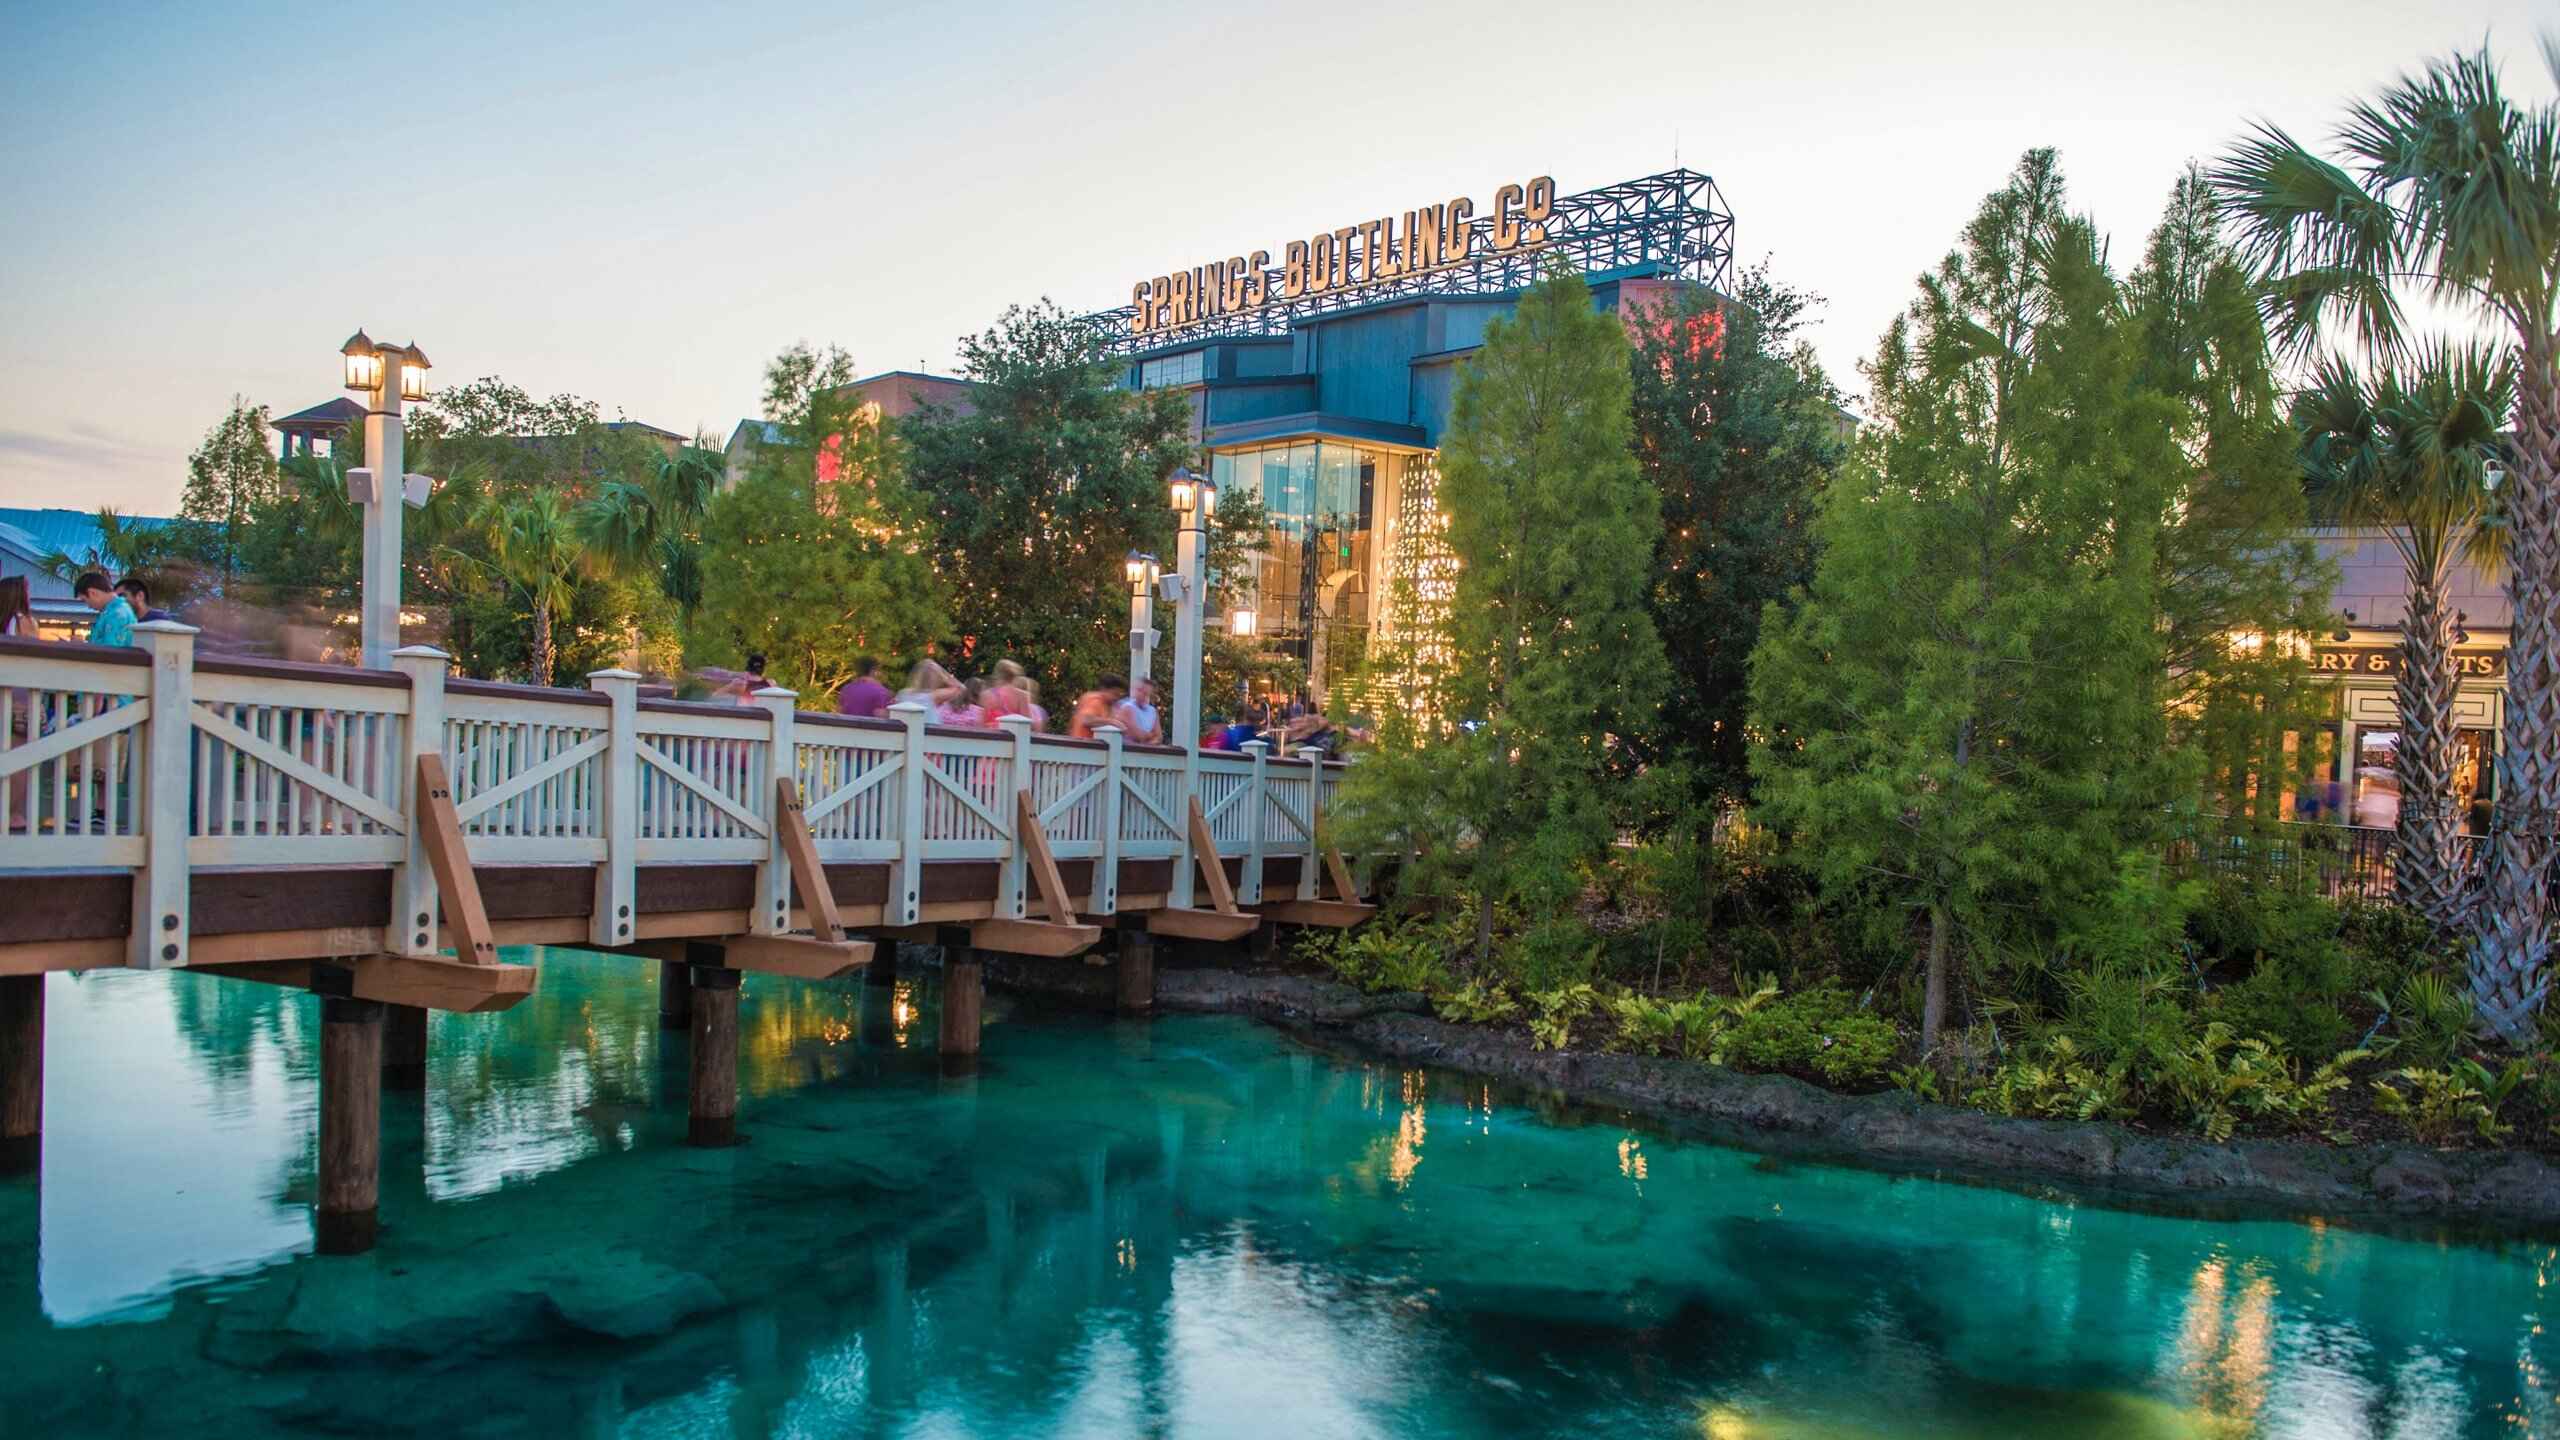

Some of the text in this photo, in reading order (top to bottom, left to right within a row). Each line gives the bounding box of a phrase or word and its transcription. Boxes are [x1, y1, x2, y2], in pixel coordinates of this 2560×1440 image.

[1131, 250, 1270, 334] SPRINGS
[1284, 197, 1474, 299] BOTTLING
[2367, 654, 2391, 671] &
